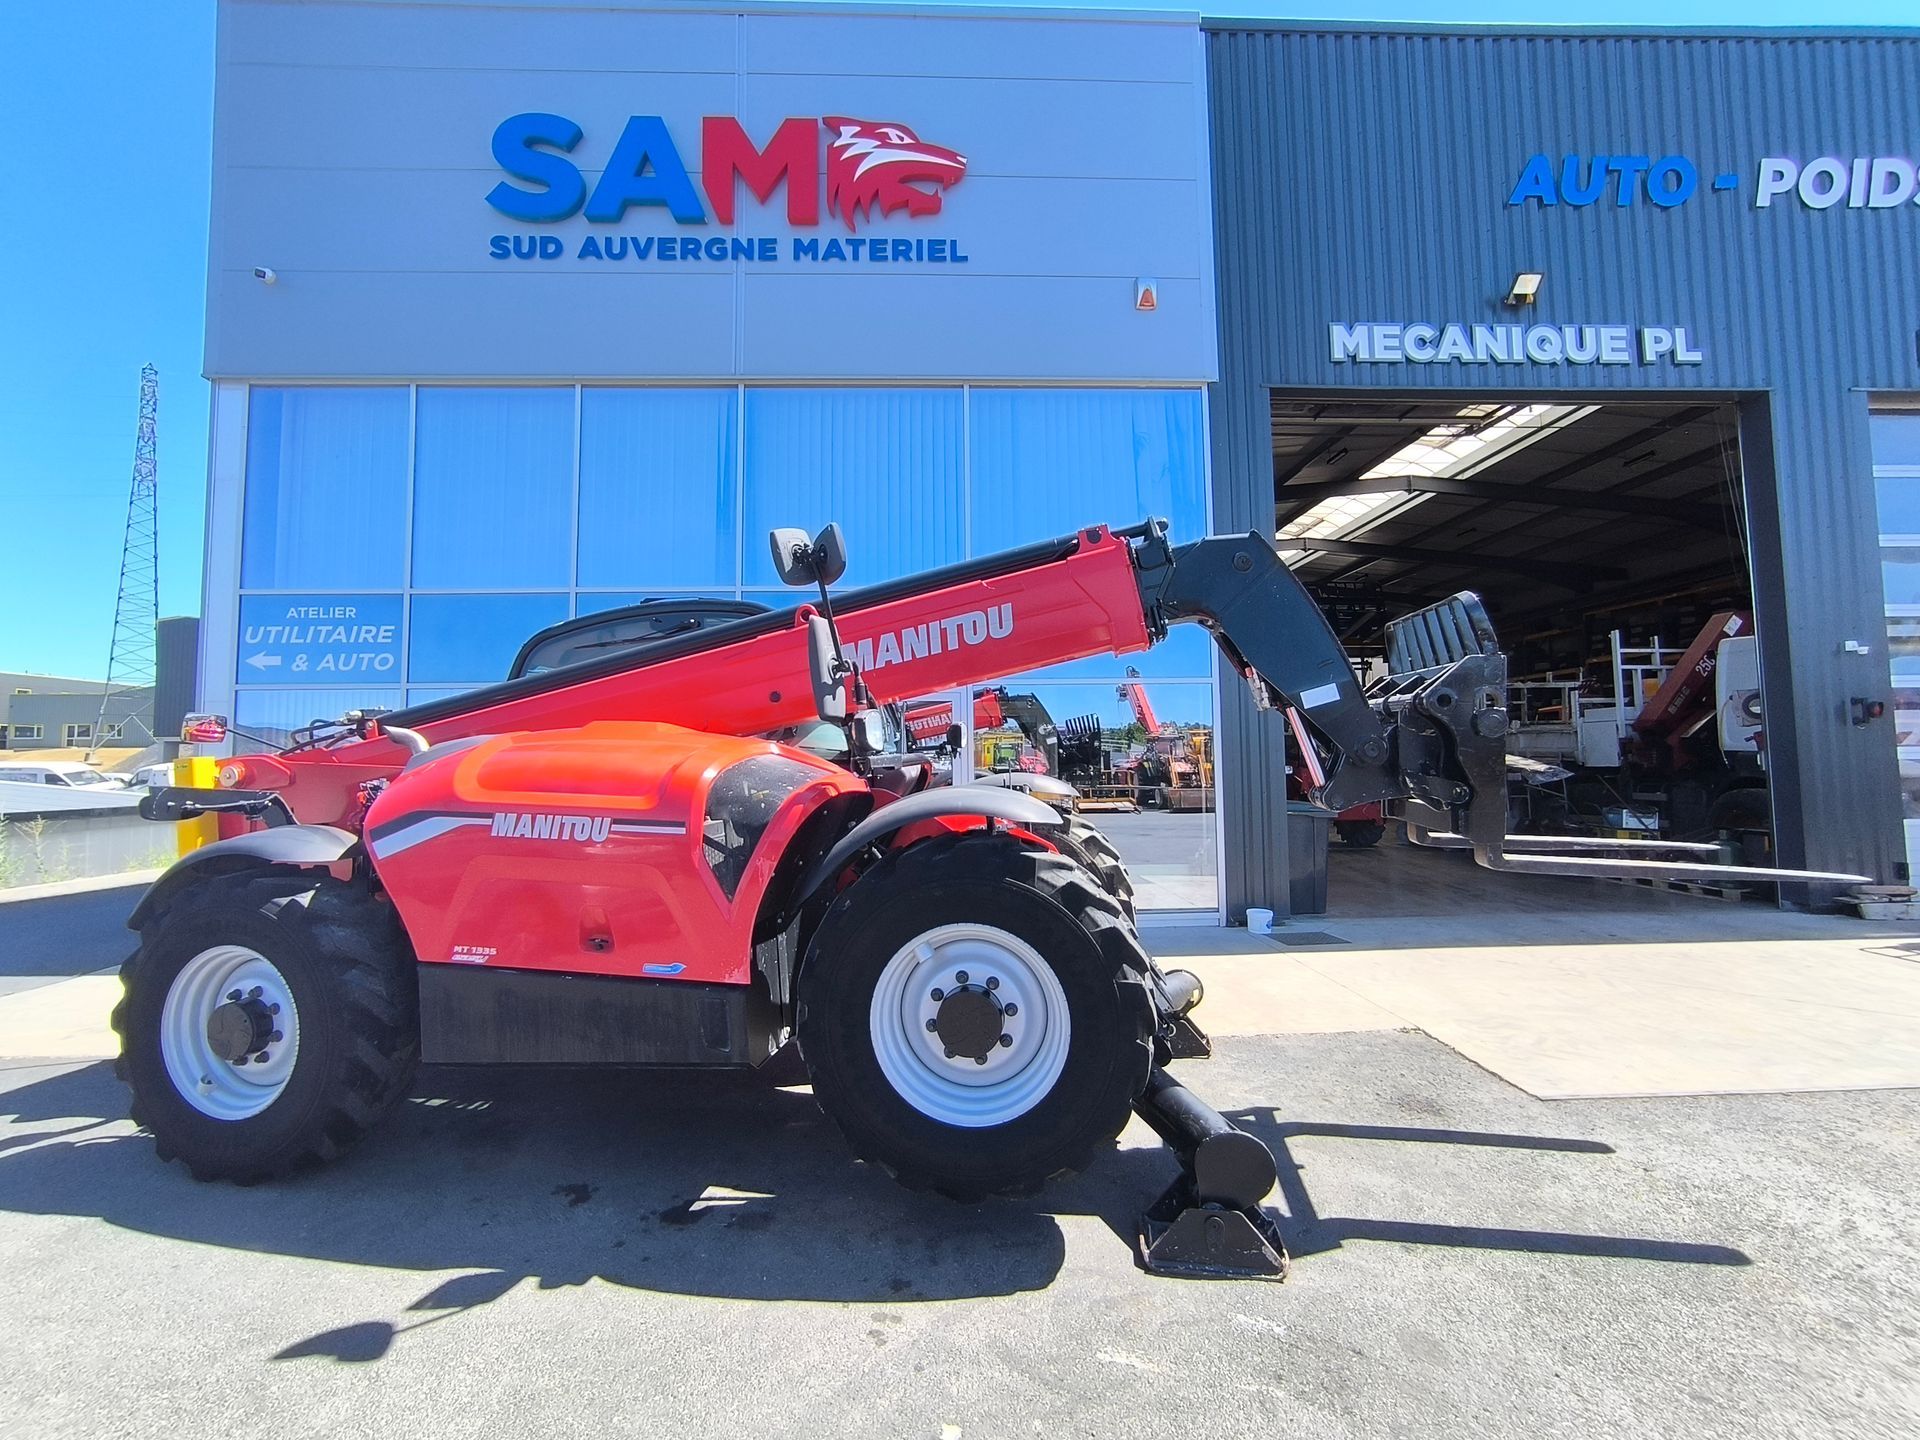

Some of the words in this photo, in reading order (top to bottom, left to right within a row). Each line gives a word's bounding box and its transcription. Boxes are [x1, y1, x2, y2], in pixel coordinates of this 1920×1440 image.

[484, 112, 820, 226] SAM
[1507, 155, 1698, 208] AUTO
[489, 234, 564, 261] SUD
[577, 235, 778, 262] AUVERGNE
[792, 237, 969, 263] MATERIEL
[1328, 321, 1632, 366] MECANIQUE
[1641, 326, 1703, 365] PL
[286, 606, 357, 619] ATELIER
[244, 625, 396, 645] UTILITAIRE
[840, 602, 1014, 673] MANITOU
[291, 653, 310, 672] &
[316, 652, 395, 672] AUTO
[490, 812, 612, 843] MANITOU
[453, 945, 470, 954] MT
